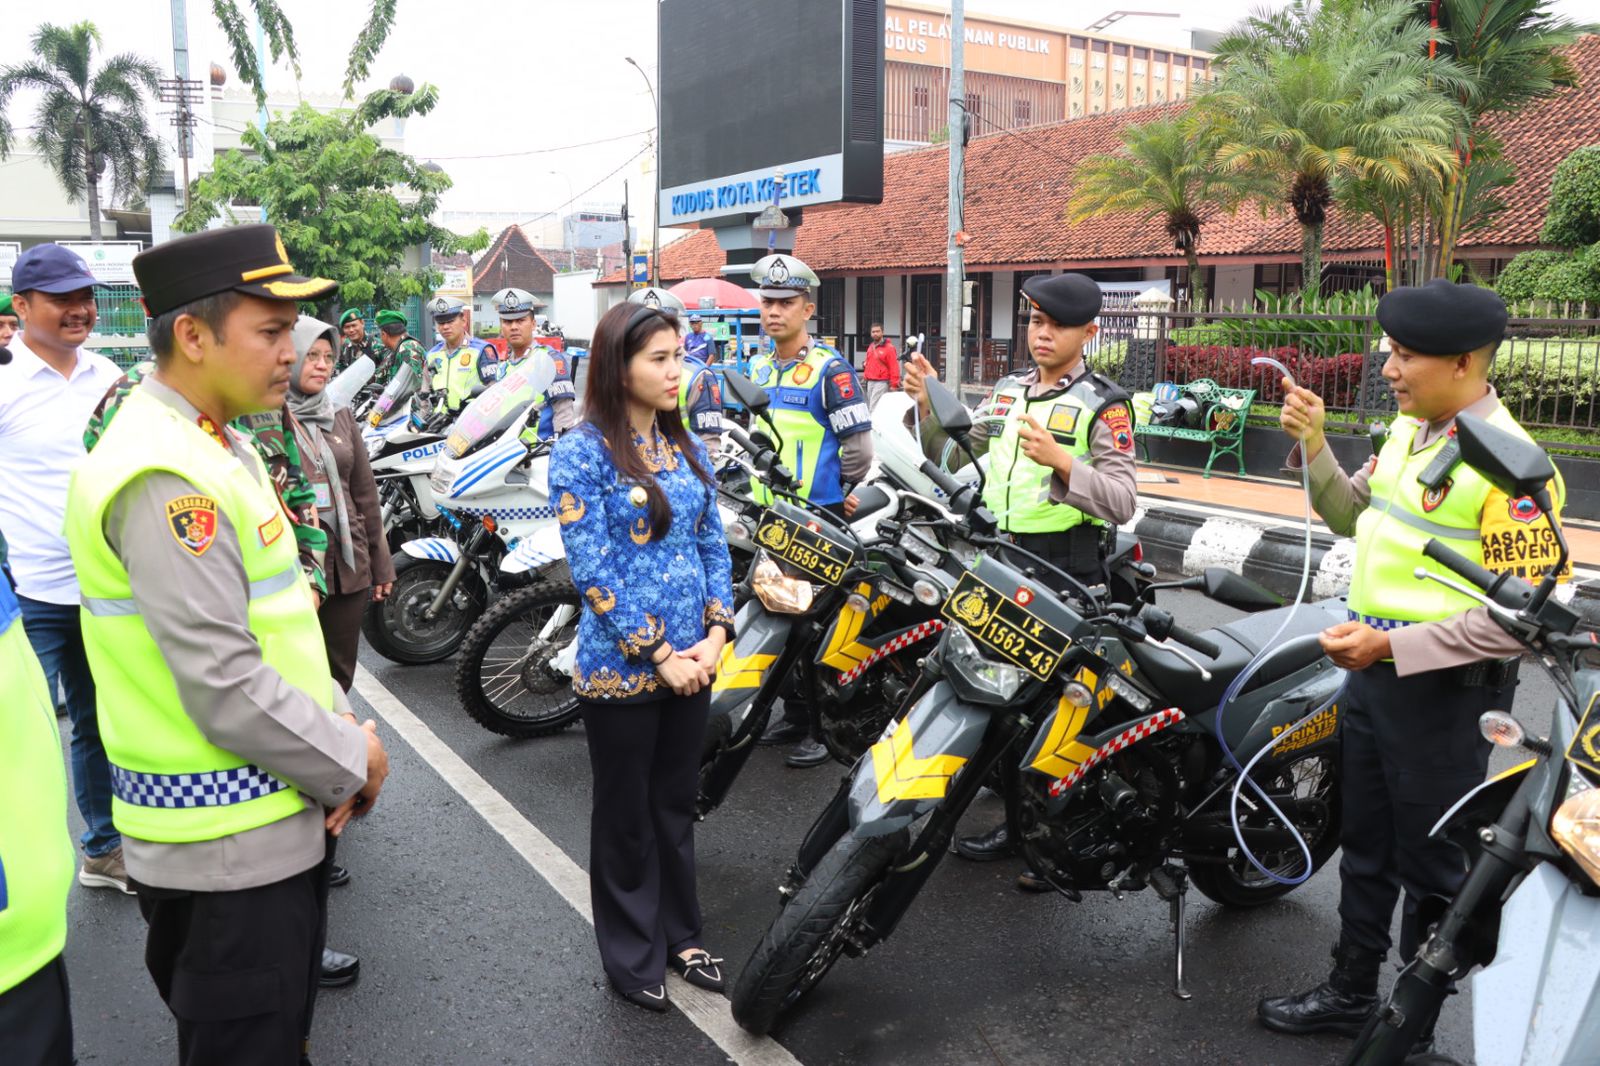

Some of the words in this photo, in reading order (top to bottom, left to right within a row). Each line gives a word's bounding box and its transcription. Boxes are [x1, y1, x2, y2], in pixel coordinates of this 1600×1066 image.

[885, 15, 904, 34] AL
[908, 19, 995, 48] PELAYNAN
[998, 31, 1050, 55] PUBLIK
[885, 33, 927, 54] UDUS
[671, 188, 715, 216] KUDUS
[716, 181, 756, 209] KOTA
[828, 402, 871, 433] PATW
[402, 441, 445, 462] POLIS
[1482, 527, 1554, 550] KASATG
[1483, 541, 1560, 565] PREVENT
[789, 544, 842, 581] 1559-43
[987, 622, 1054, 676] 1562-43
